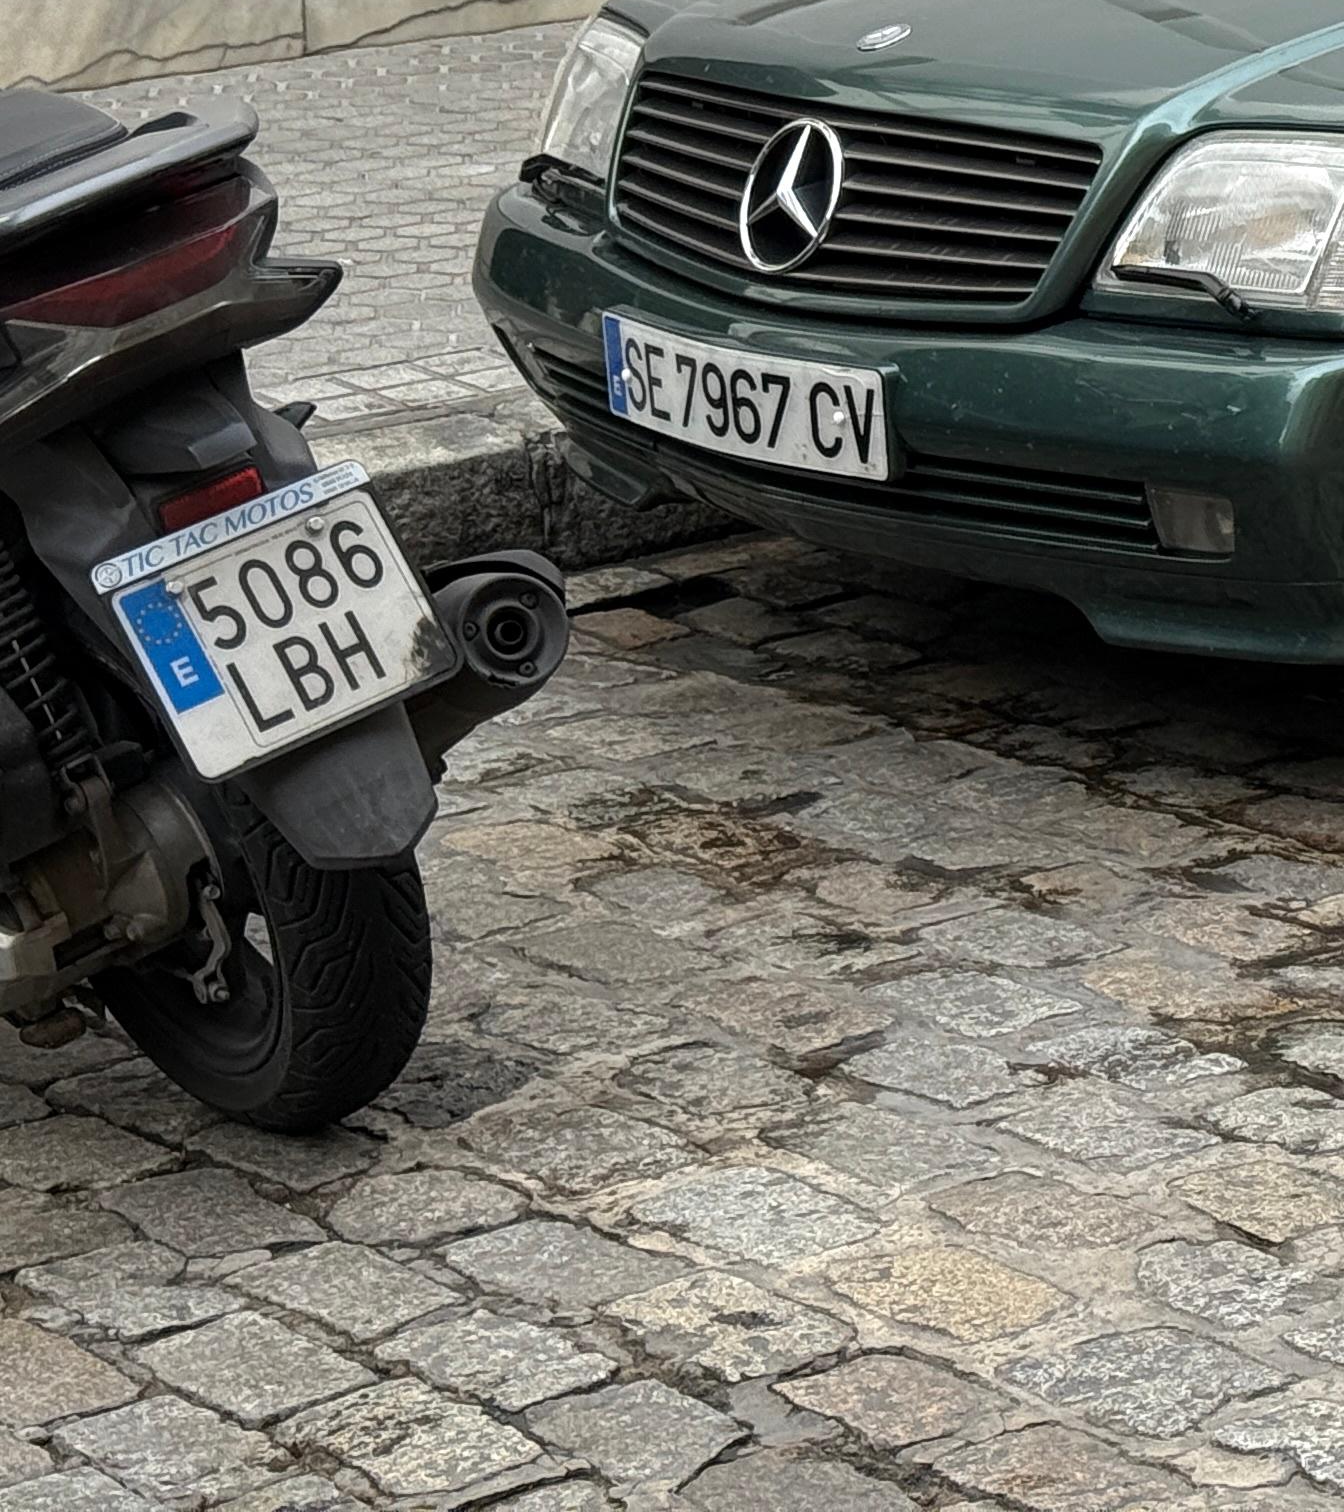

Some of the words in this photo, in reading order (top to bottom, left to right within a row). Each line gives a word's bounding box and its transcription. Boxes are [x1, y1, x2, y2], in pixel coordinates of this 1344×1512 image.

[625, 337, 671, 421] SE
[676, 354, 791, 449] 7967
[809, 381, 875, 464] CV
[121, 540, 167, 579] TIC
[171, 519, 219, 558] TAC
[224, 483, 315, 537] MOTOS
[187, 519, 384, 651] 5086
[170, 656, 199, 688] E
[227, 610, 387, 733] LBH
